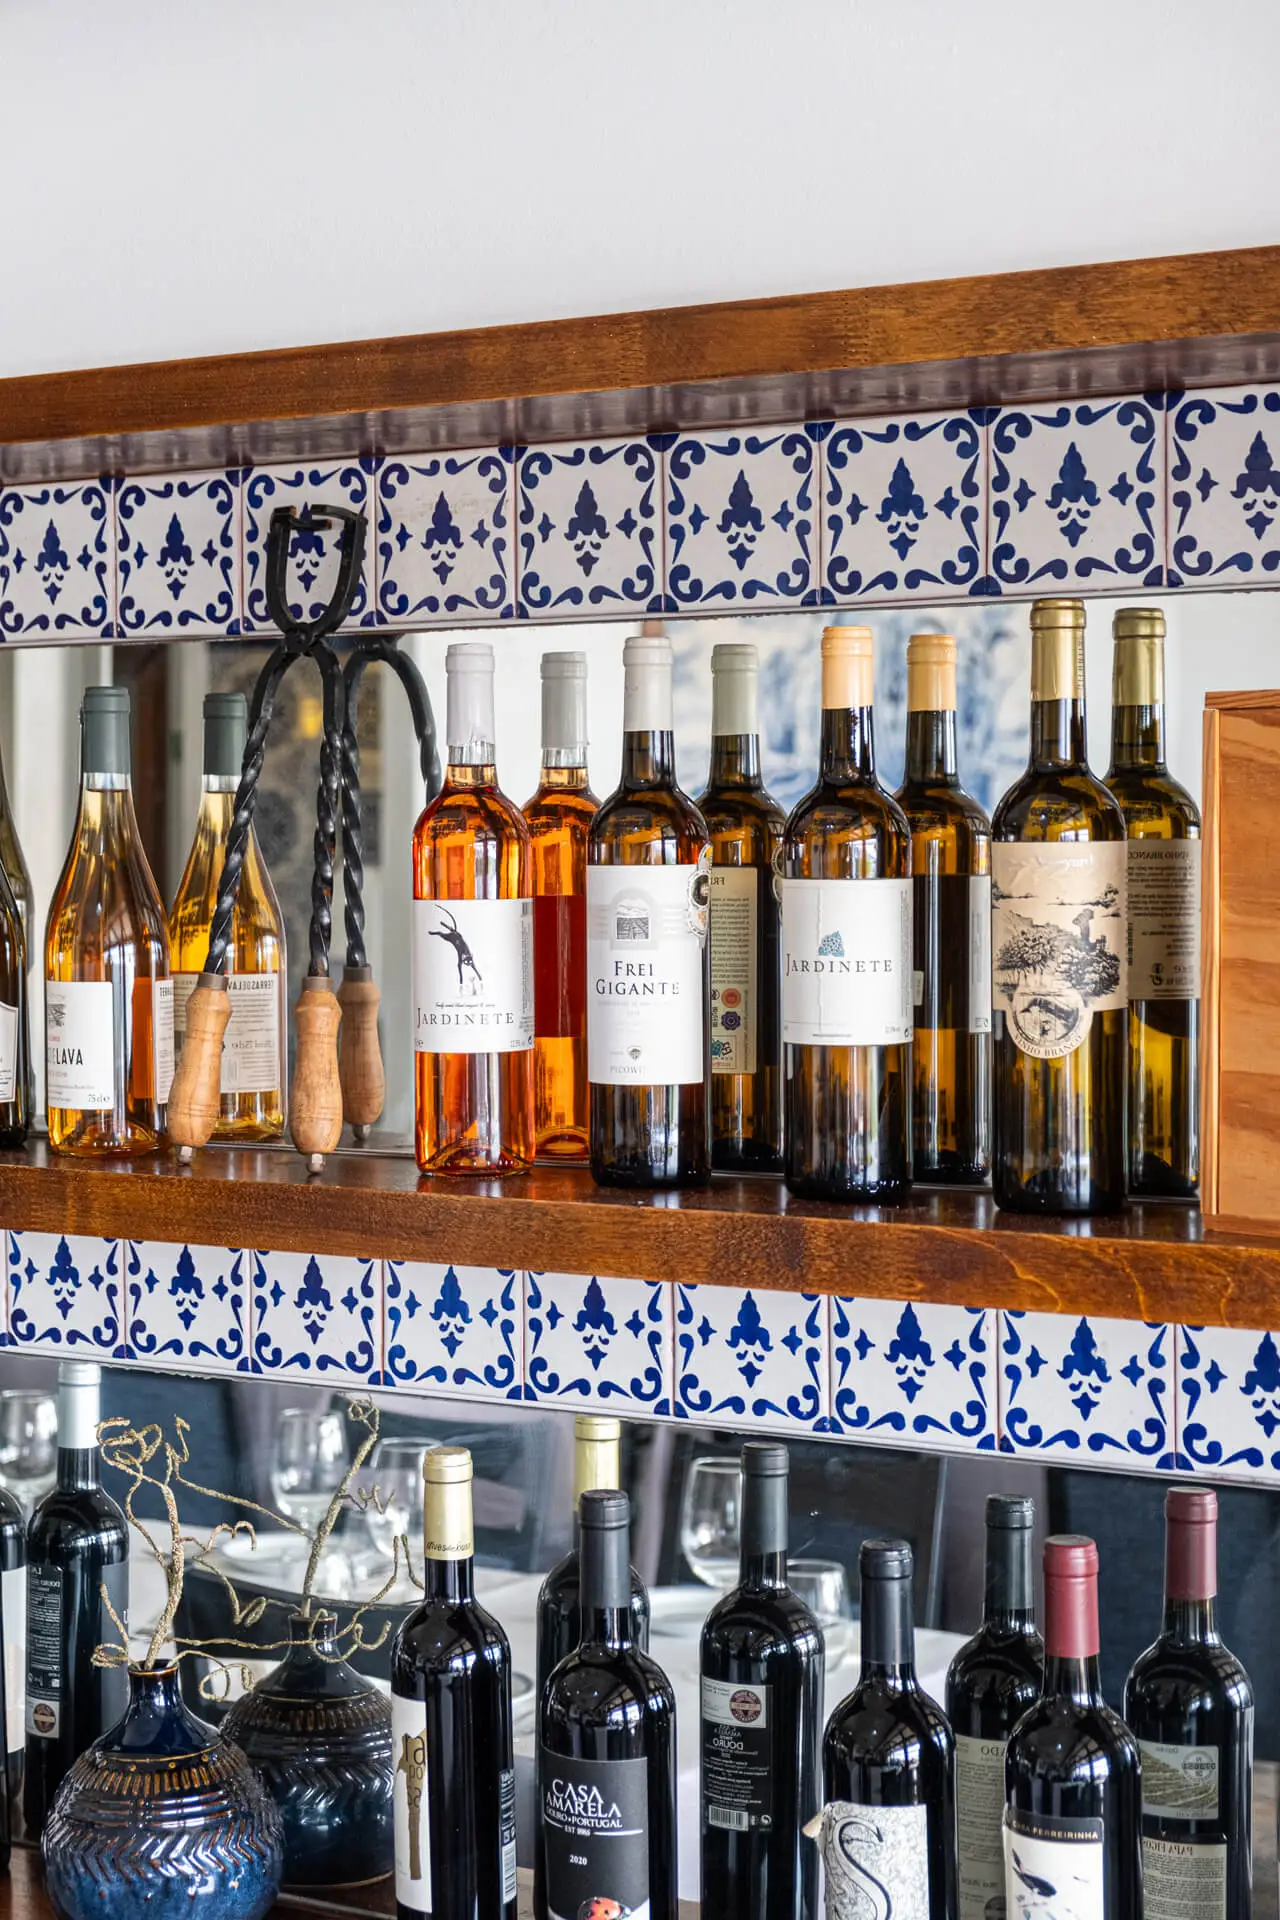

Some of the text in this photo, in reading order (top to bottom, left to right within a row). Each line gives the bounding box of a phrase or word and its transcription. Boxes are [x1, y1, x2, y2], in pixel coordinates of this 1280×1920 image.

[614, 960, 654, 977] FREI
[785, 953, 893, 976] JARDINETE
[596, 978, 680, 996] GIGANTE
[417, 1007, 514, 1029] JARDINETE
[1014, 1033, 1041, 1056] VINHO
[552, 1779, 604, 1804] CASA
[546, 1791, 622, 1818] AMARELA
[571, 1815, 623, 1829] PORTUGAL
[1032, 1825, 1099, 1840] FERREIRINHA
[569, 1854, 588, 1866] 2020
